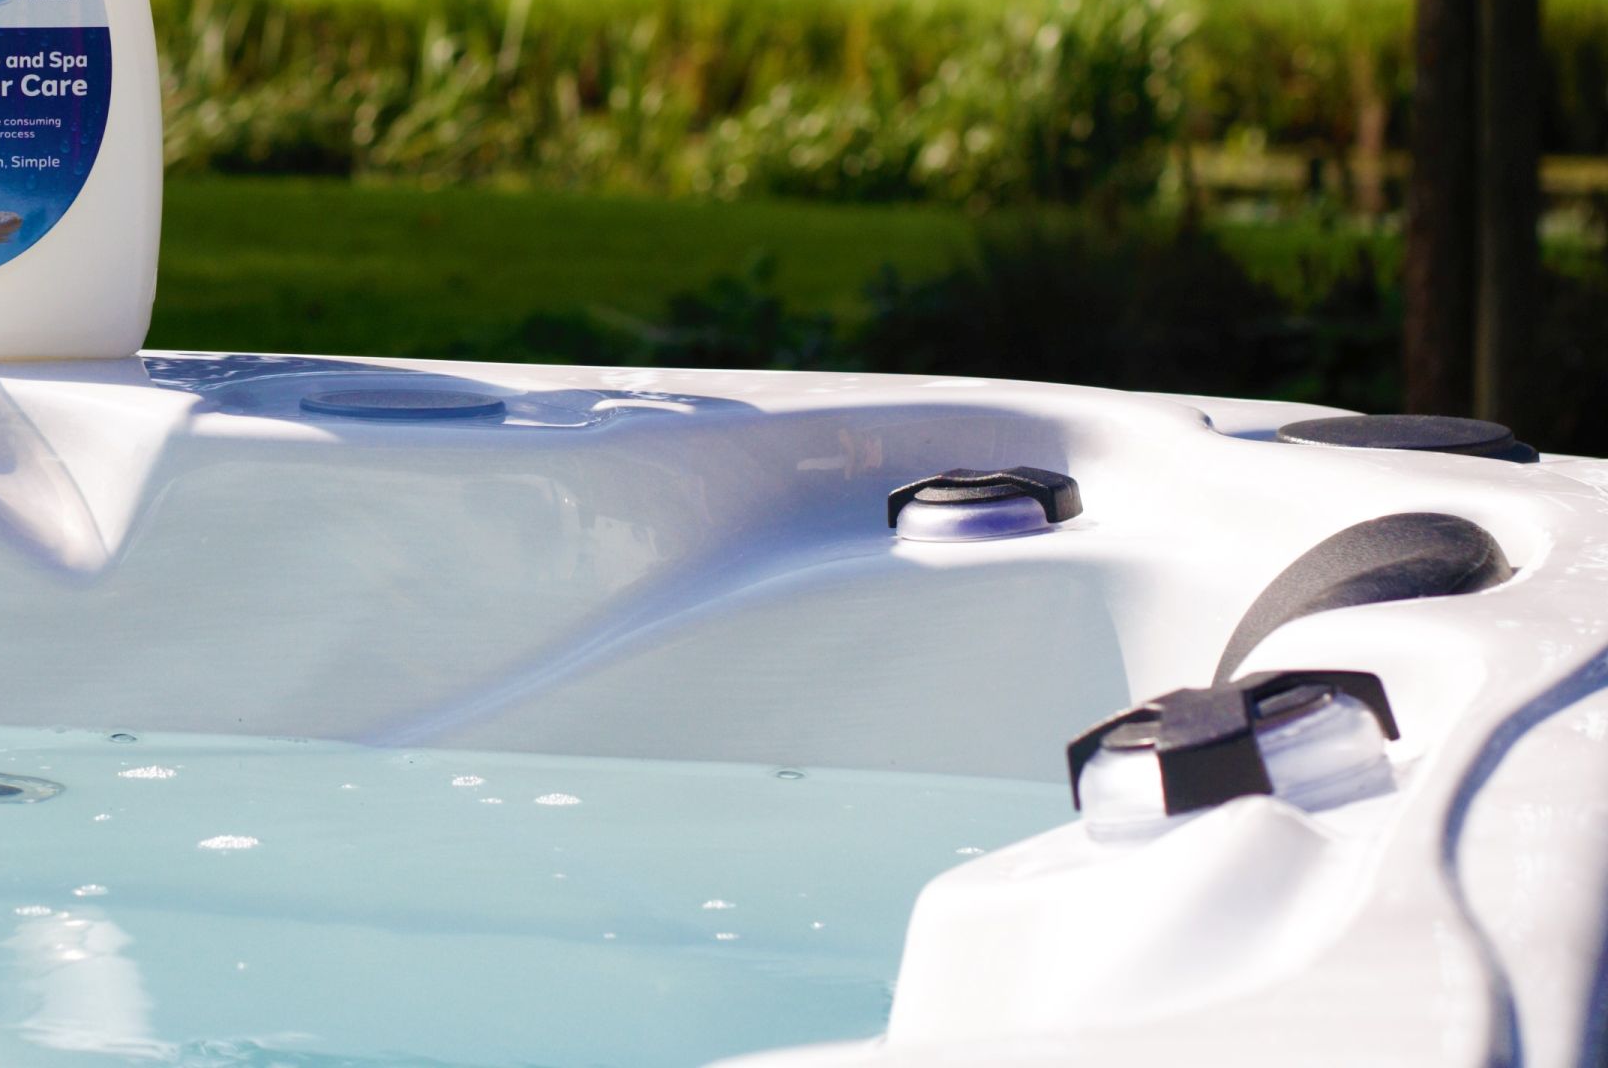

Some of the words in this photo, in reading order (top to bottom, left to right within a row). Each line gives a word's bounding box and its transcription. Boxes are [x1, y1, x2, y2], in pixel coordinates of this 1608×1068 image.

[6, 52, 44, 68] and
[49, 51, 88, 72] Spa
[21, 74, 88, 97] Care
[4, 117, 61, 128] consuming
[11, 155, 61, 171] Simple
